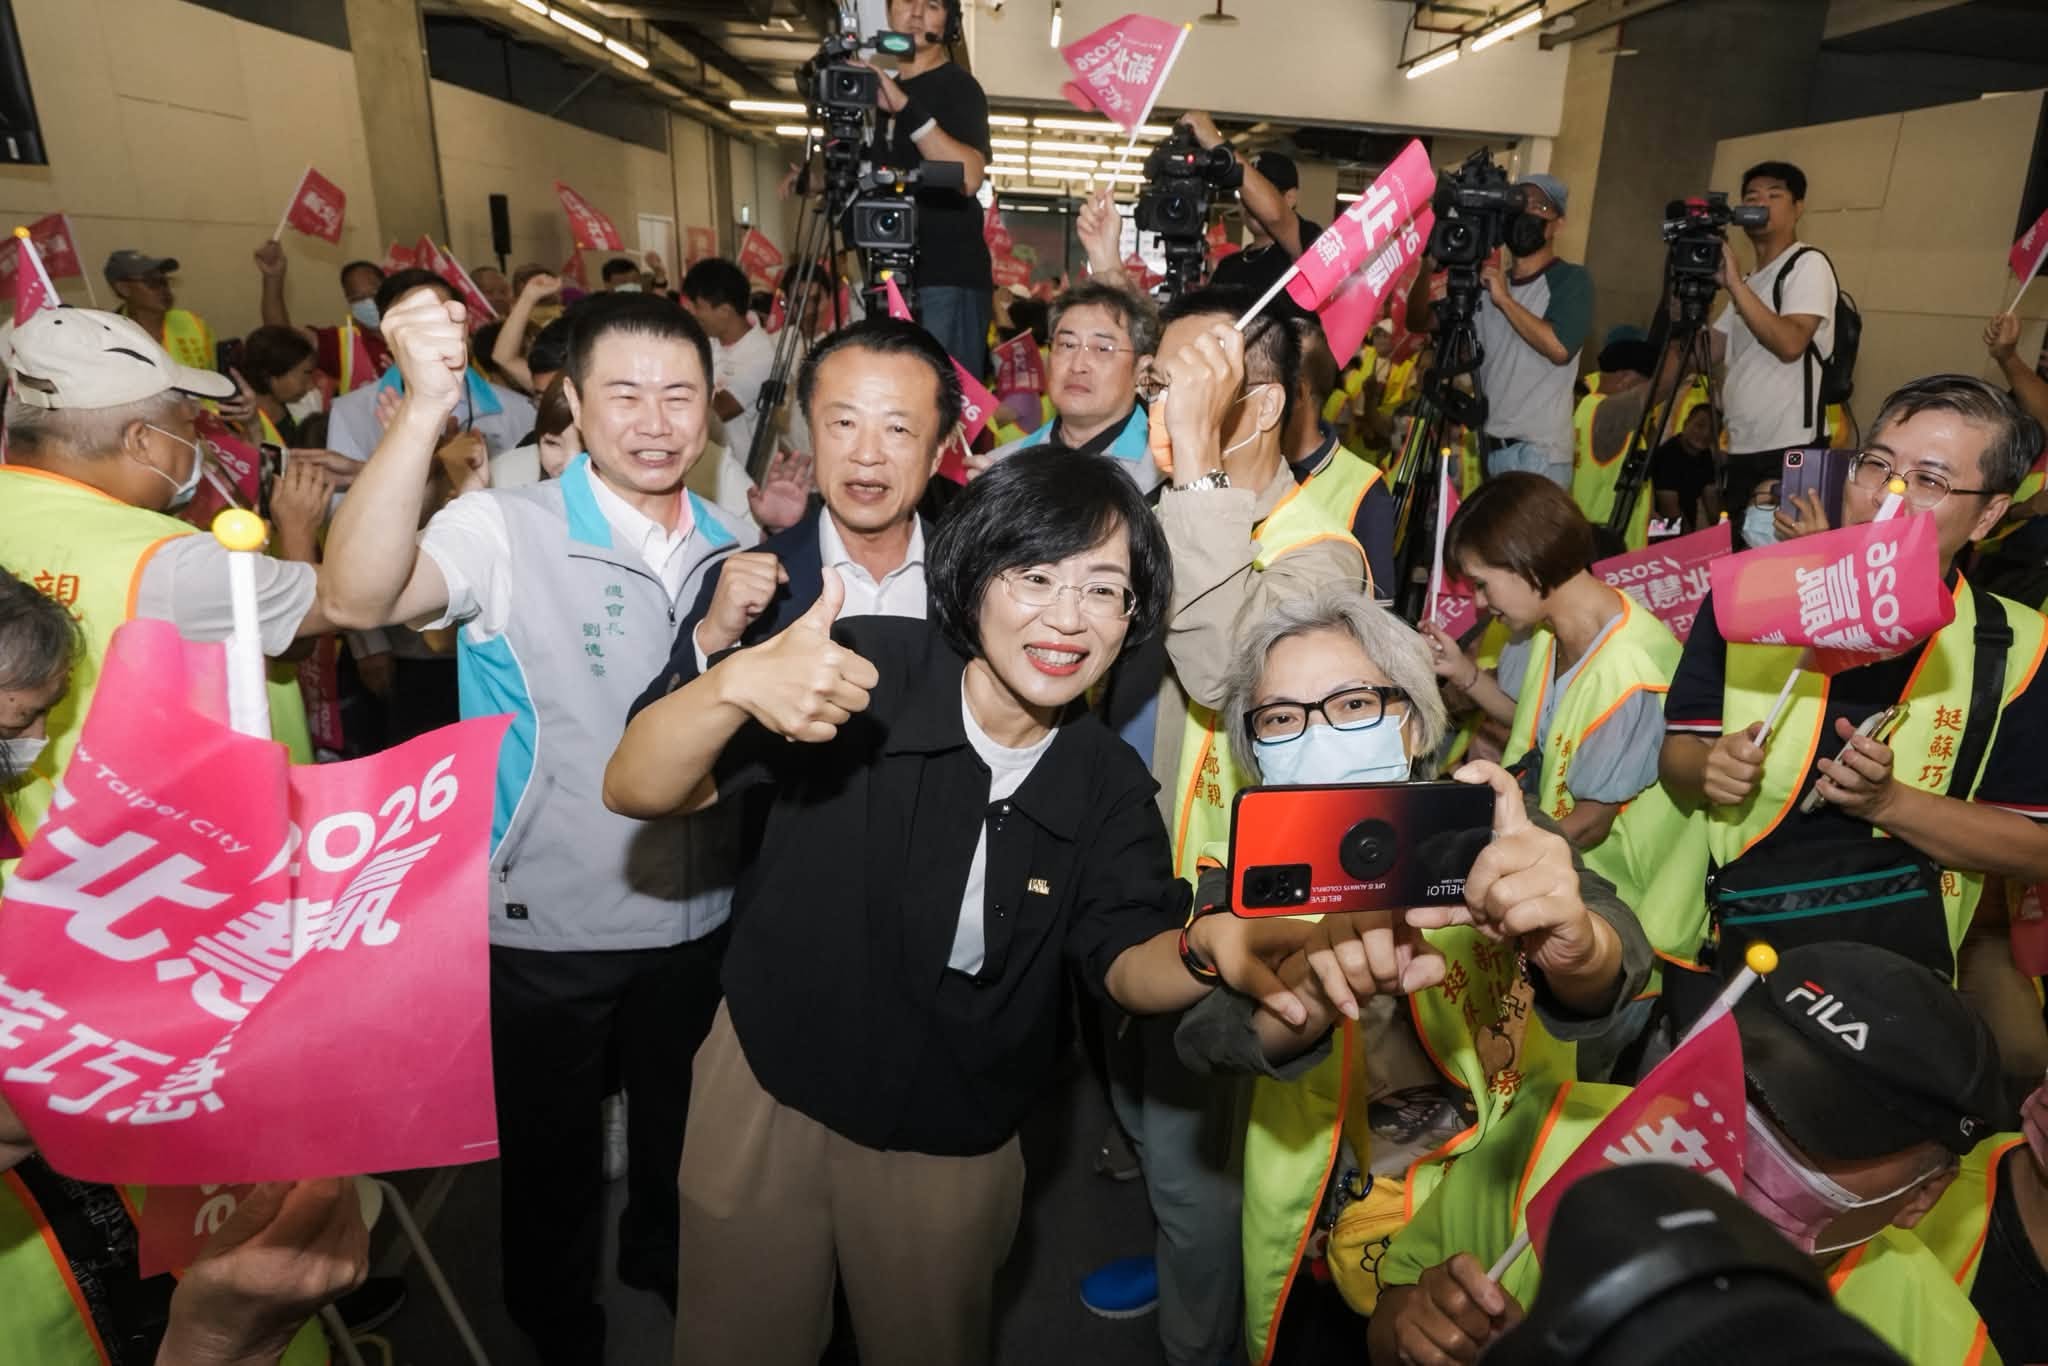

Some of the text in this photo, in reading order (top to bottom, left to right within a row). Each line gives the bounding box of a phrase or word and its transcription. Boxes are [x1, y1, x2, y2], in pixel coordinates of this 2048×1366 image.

[1918, 704, 1963, 788] 挺蘇巧
[95, 764, 250, 853] Taipei City
[1310, 894, 1342, 904] BELIEVE
[1426, 883, 1465, 897] HELLO!
[1785, 980, 1870, 1052] FILA
